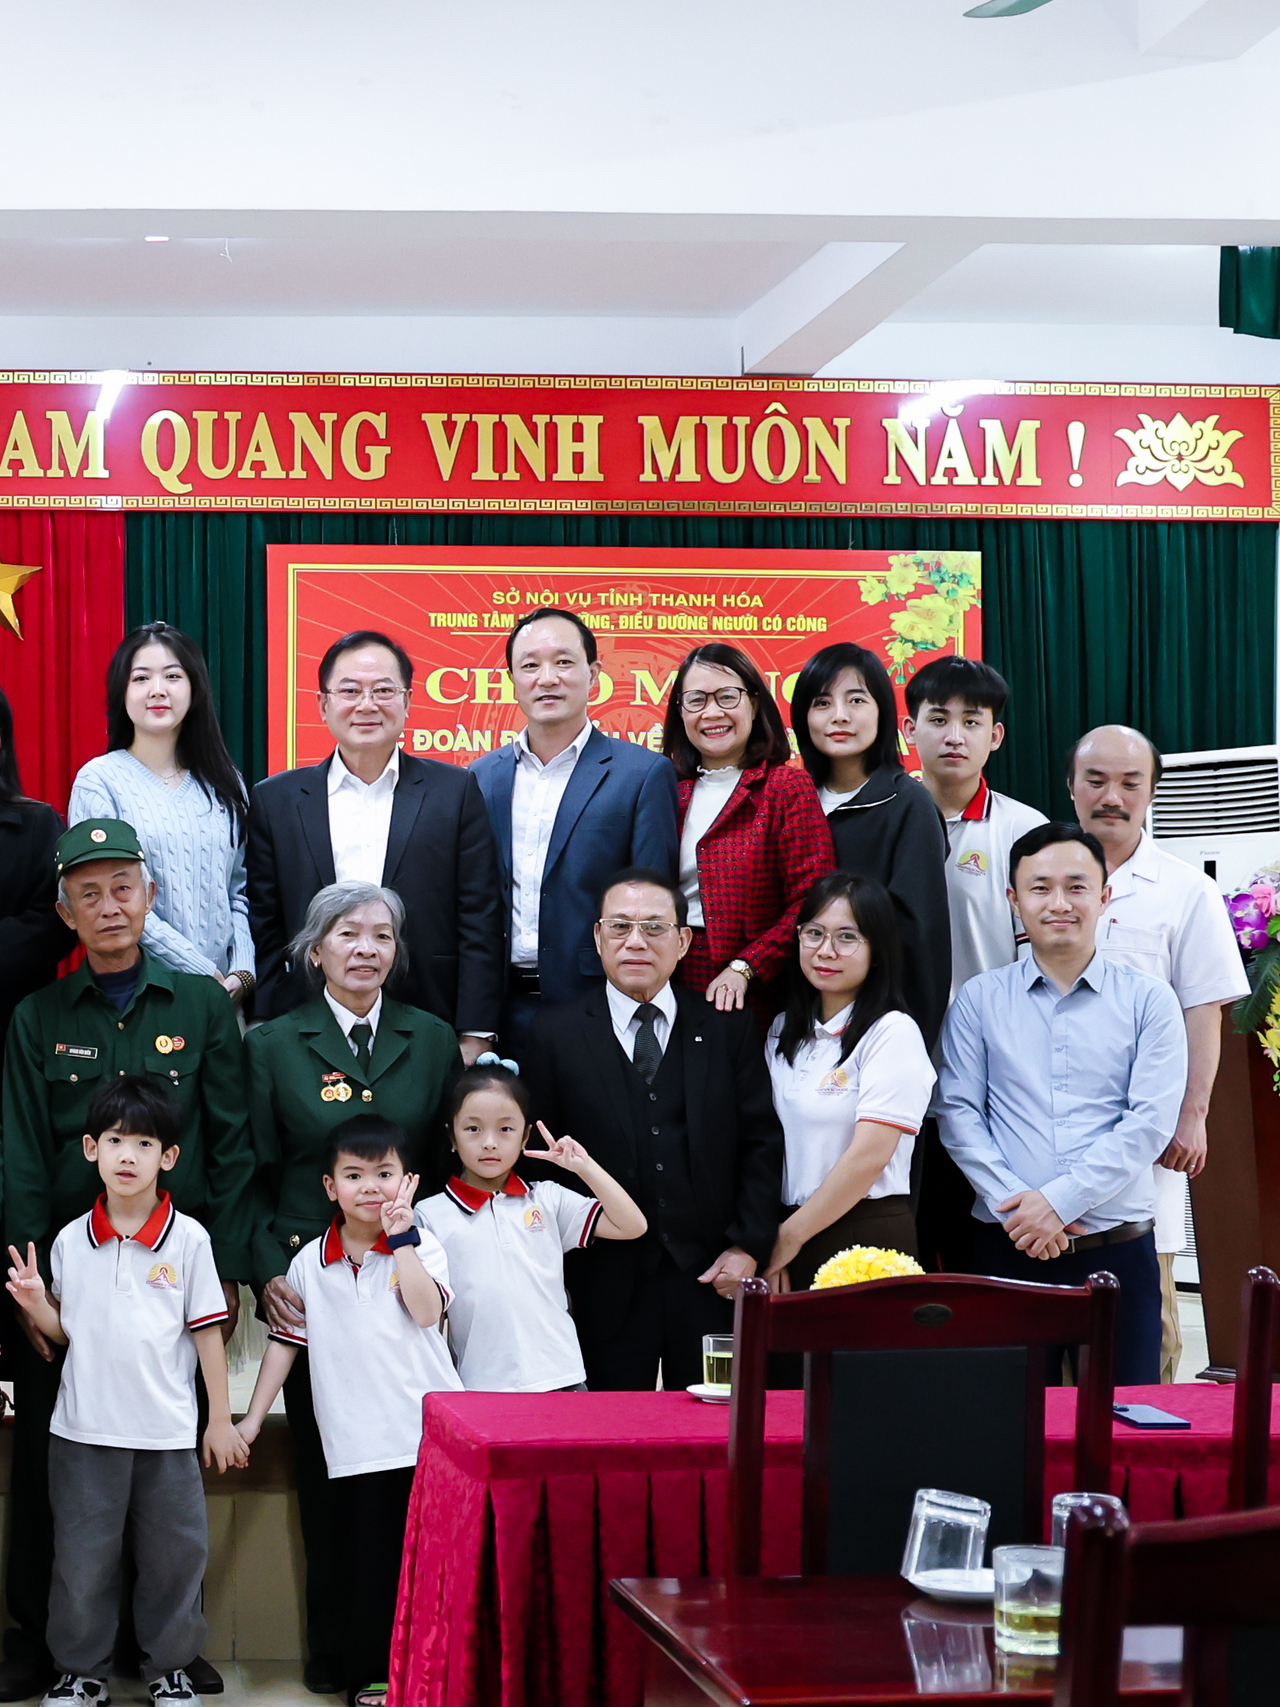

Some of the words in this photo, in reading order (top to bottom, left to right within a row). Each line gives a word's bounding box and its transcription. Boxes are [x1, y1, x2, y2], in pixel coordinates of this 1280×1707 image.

[140, 410, 391, 495] QUANG
[421, 412, 604, 482] VINH
[637, 401, 851, 484] MUÔN
[881, 404, 1042, 486] NĂM
[1066, 421, 1085, 488] !
[492, 586, 521, 605] SỞ
[525, 588, 559, 608] NỘI
[564, 591, 592, 608] VỤ
[597, 587, 643, 606] TỈNH
[648, 592, 716, 607] THANH
[722, 591, 764, 608] HÓA
[428, 612, 478, 628] TRUNG
[482, 610, 515, 628] TÂM
[618, 610, 654, 630] ĐIỀU
[657, 612, 708, 630] DƯỠNG
[712, 613, 758, 631] NGƯỜI
[762, 613, 782, 631] CÓ
[786, 614, 828, 632] CÔNG
[412, 724, 492, 752] ĐOÀN
